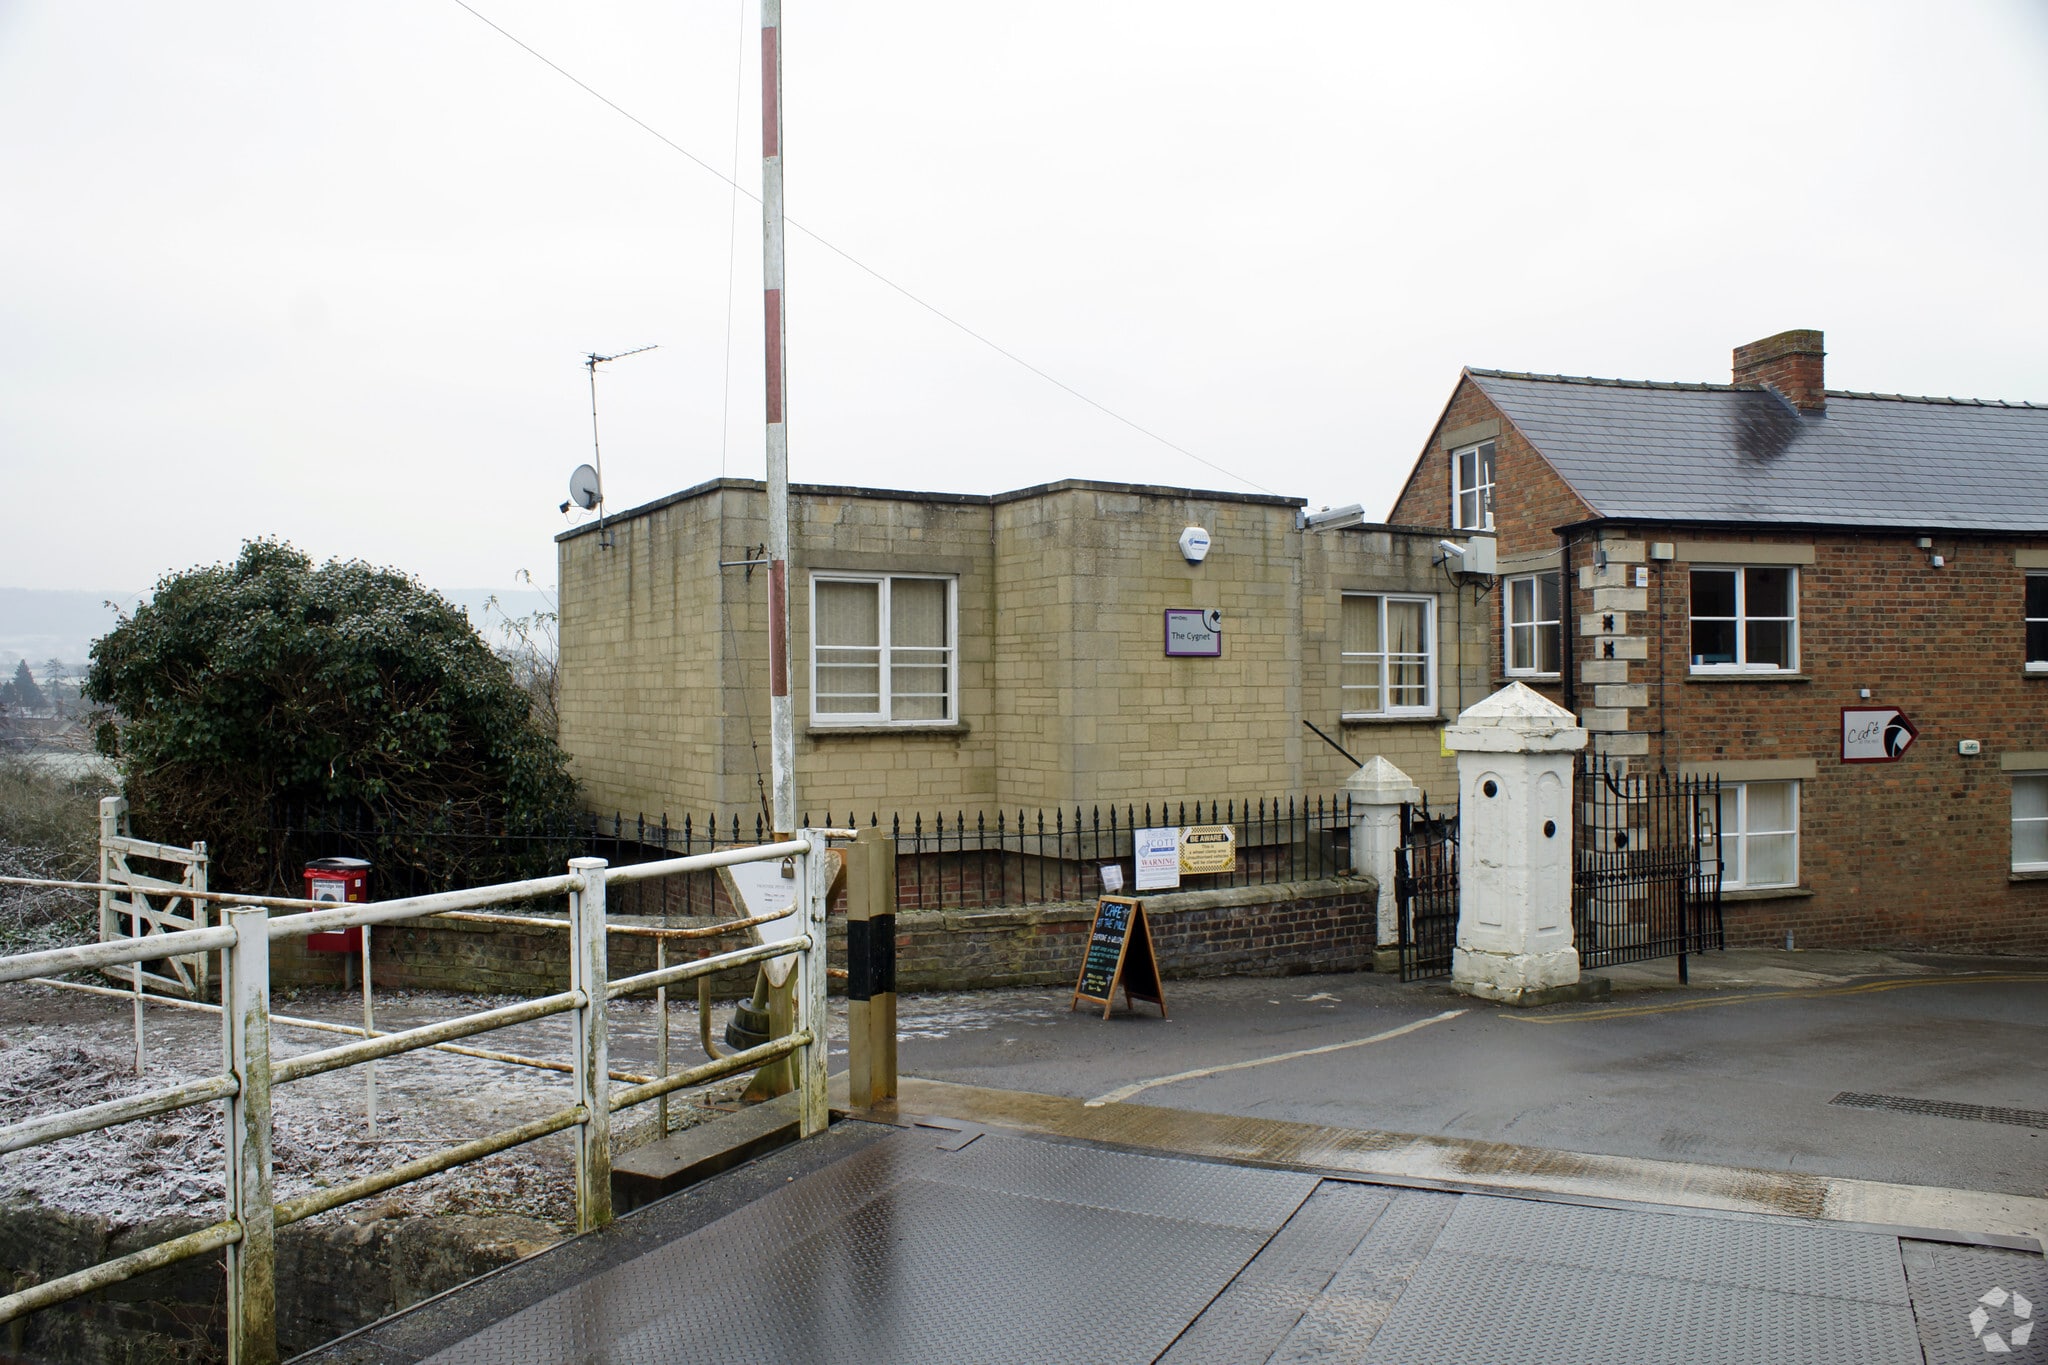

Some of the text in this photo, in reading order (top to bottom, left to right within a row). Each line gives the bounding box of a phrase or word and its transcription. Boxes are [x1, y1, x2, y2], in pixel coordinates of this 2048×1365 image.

[1172, 632, 1210, 641] The Cygnet
[1848, 722, 1879, 743] Café
[1190, 834, 1199, 842] BE
[1200, 833, 1222, 842] AWARE
[1147, 838, 1174, 847] SCOTT
[1141, 858, 1175, 866] WARNING
